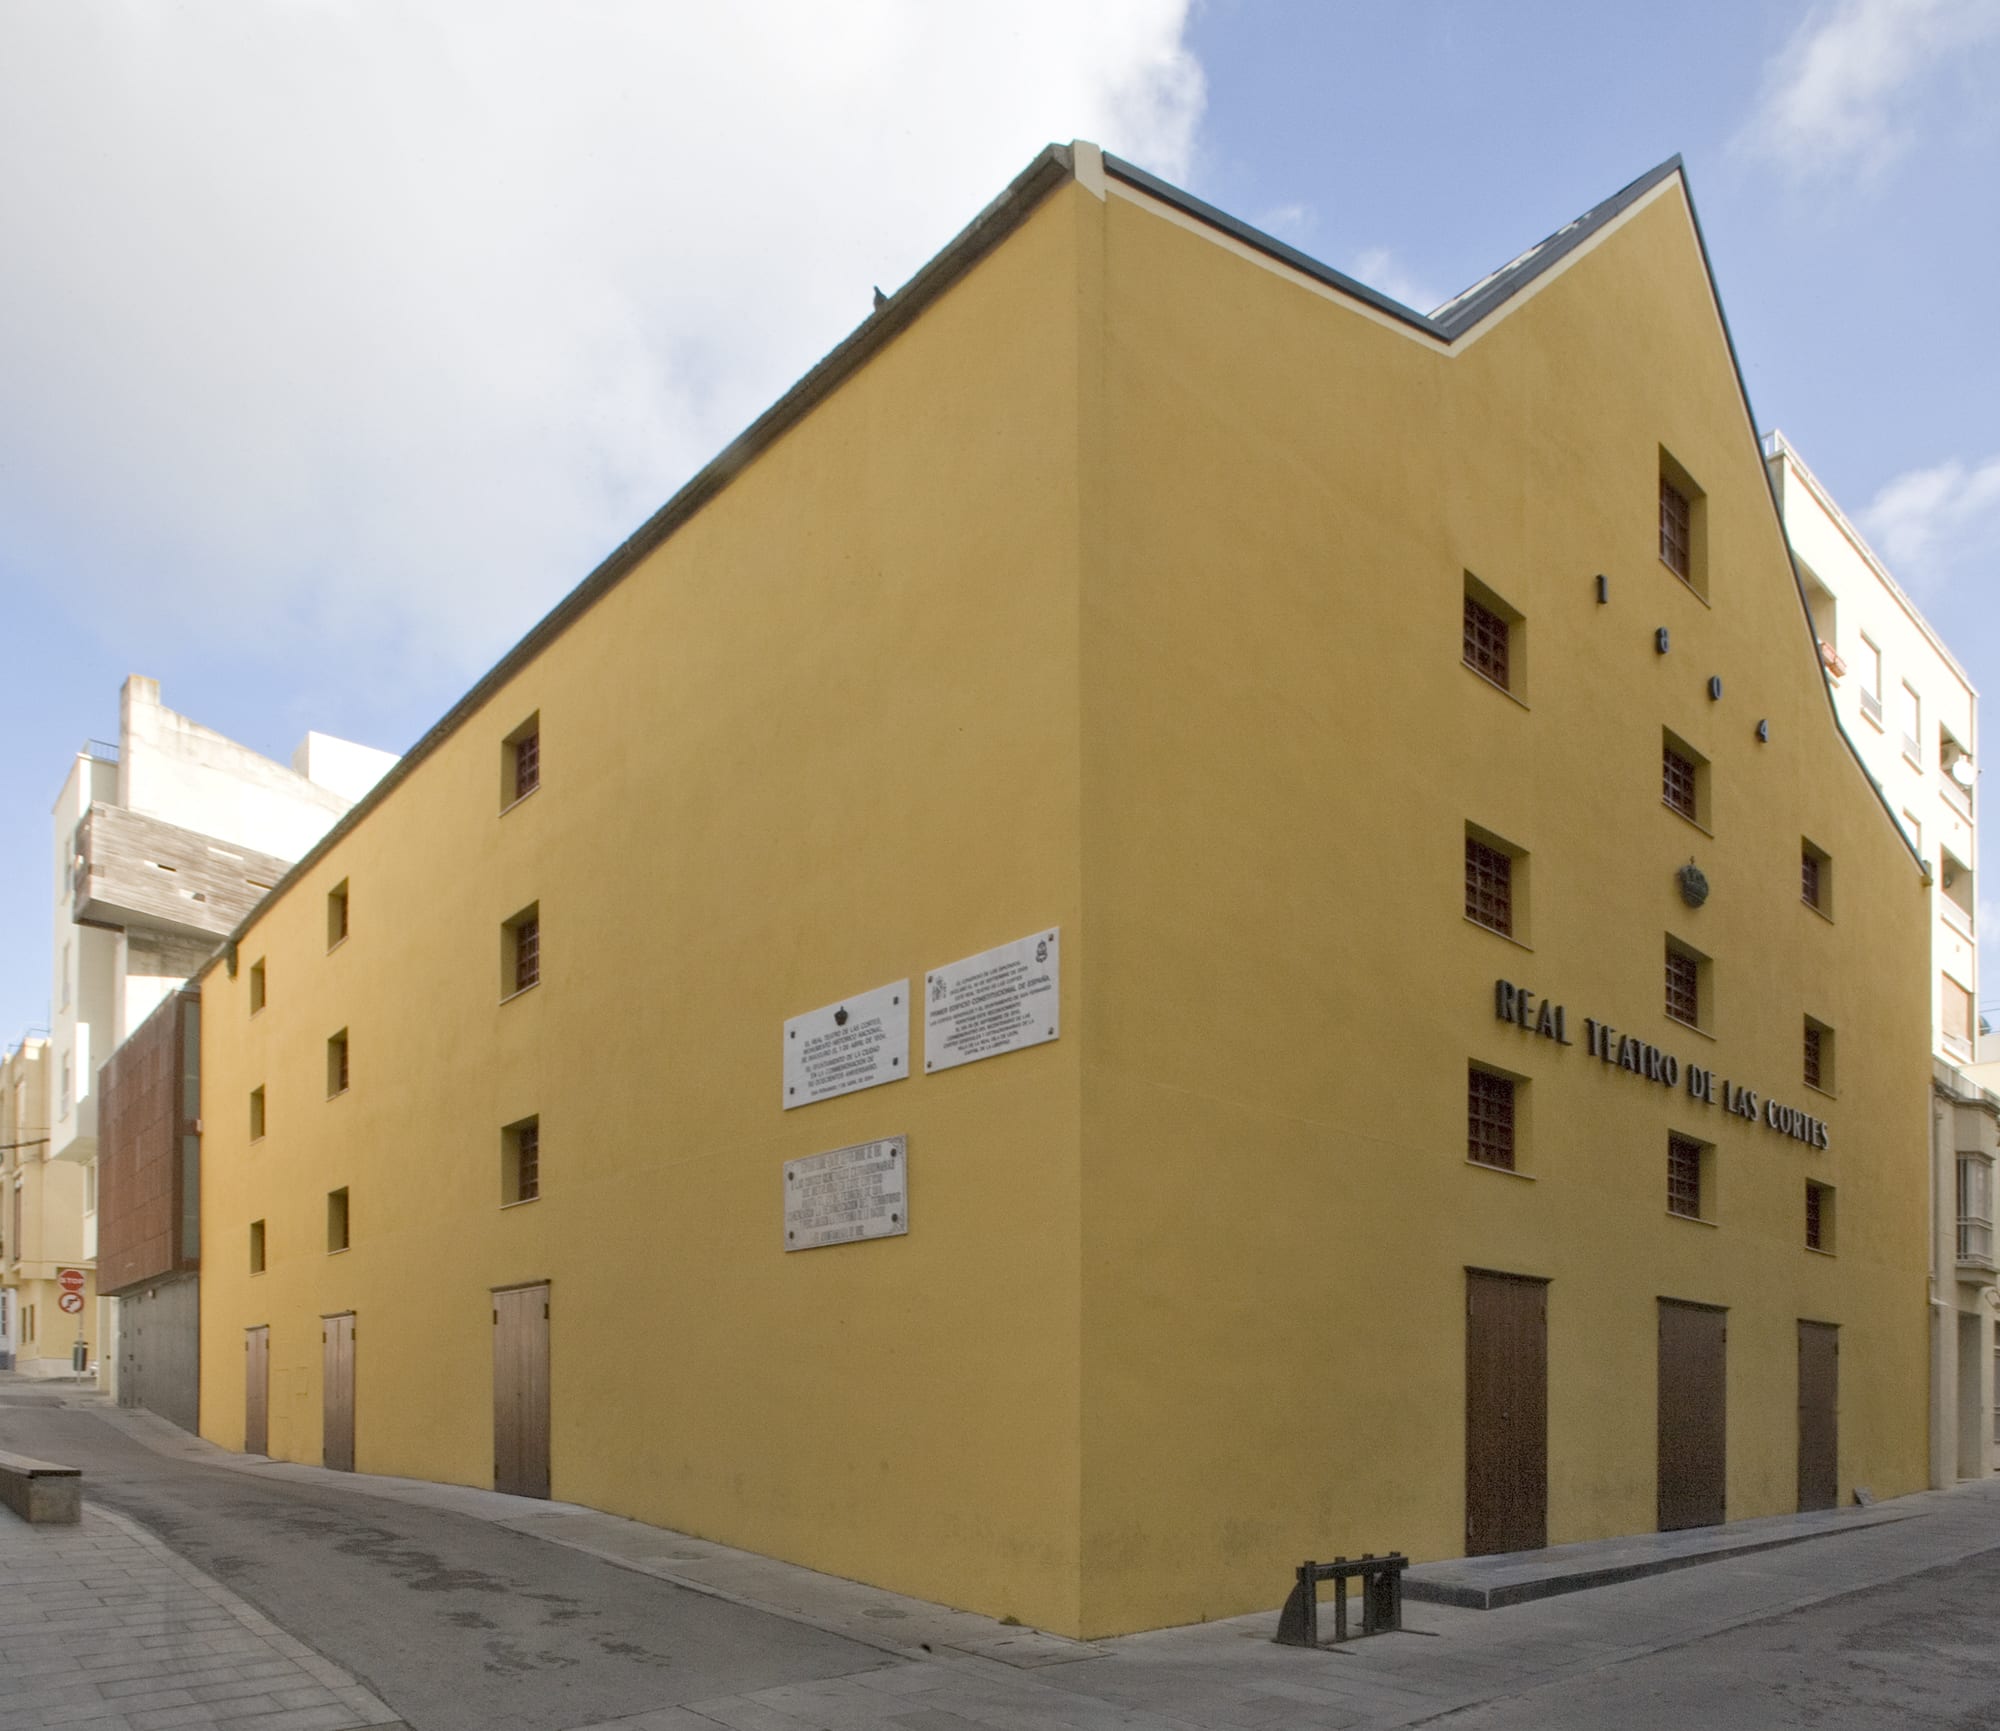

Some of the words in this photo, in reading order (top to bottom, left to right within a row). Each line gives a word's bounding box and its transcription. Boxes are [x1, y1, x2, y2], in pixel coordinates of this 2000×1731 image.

[1495, 979, 1572, 1046] REAL
[1584, 1017, 1679, 1087] TEATRO
[1687, 1063, 1717, 1104] DE
[1724, 1079, 1759, 1122] LAS
[1766, 1099, 1830, 1150] CORTES
